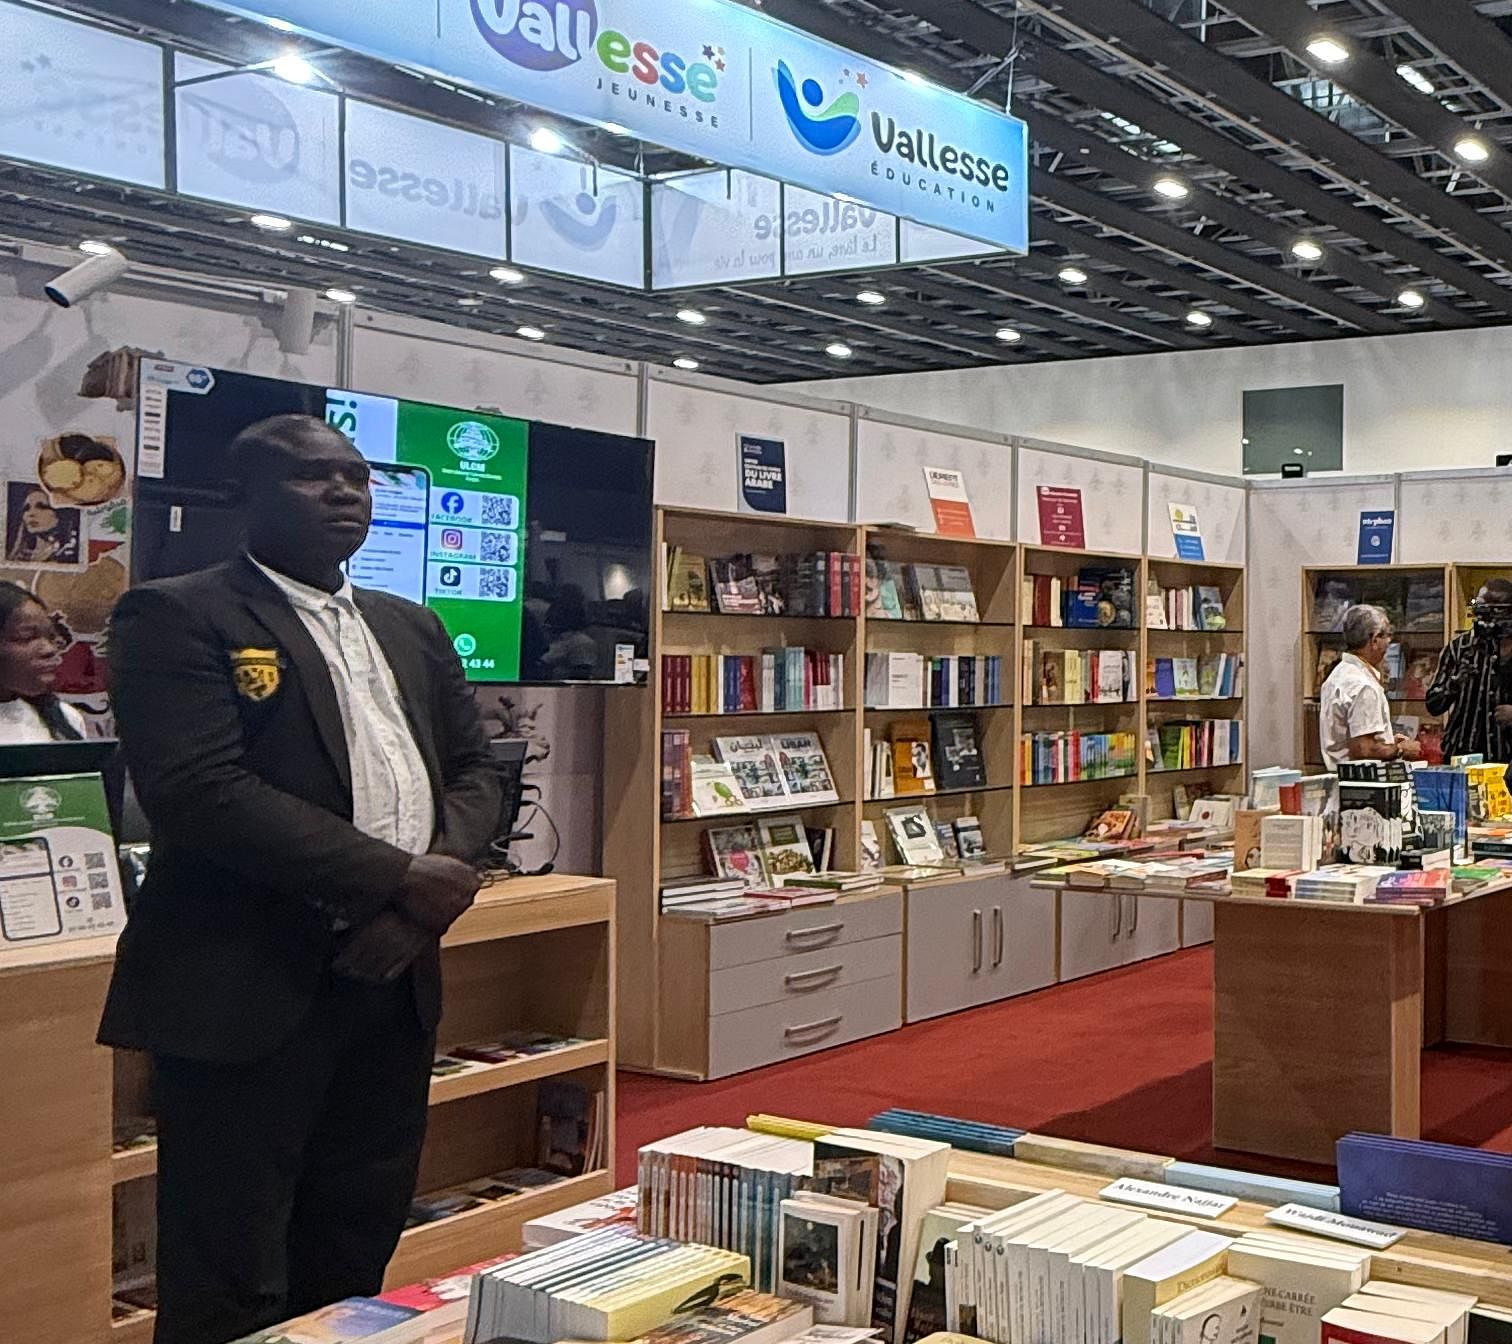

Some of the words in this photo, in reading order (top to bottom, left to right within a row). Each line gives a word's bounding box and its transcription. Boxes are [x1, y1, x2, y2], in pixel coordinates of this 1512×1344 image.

[596, 78, 719, 128] JEUNESSE
[871, 111, 1009, 193] Vallesse
[870, 160, 995, 213] ÉDUCATION
